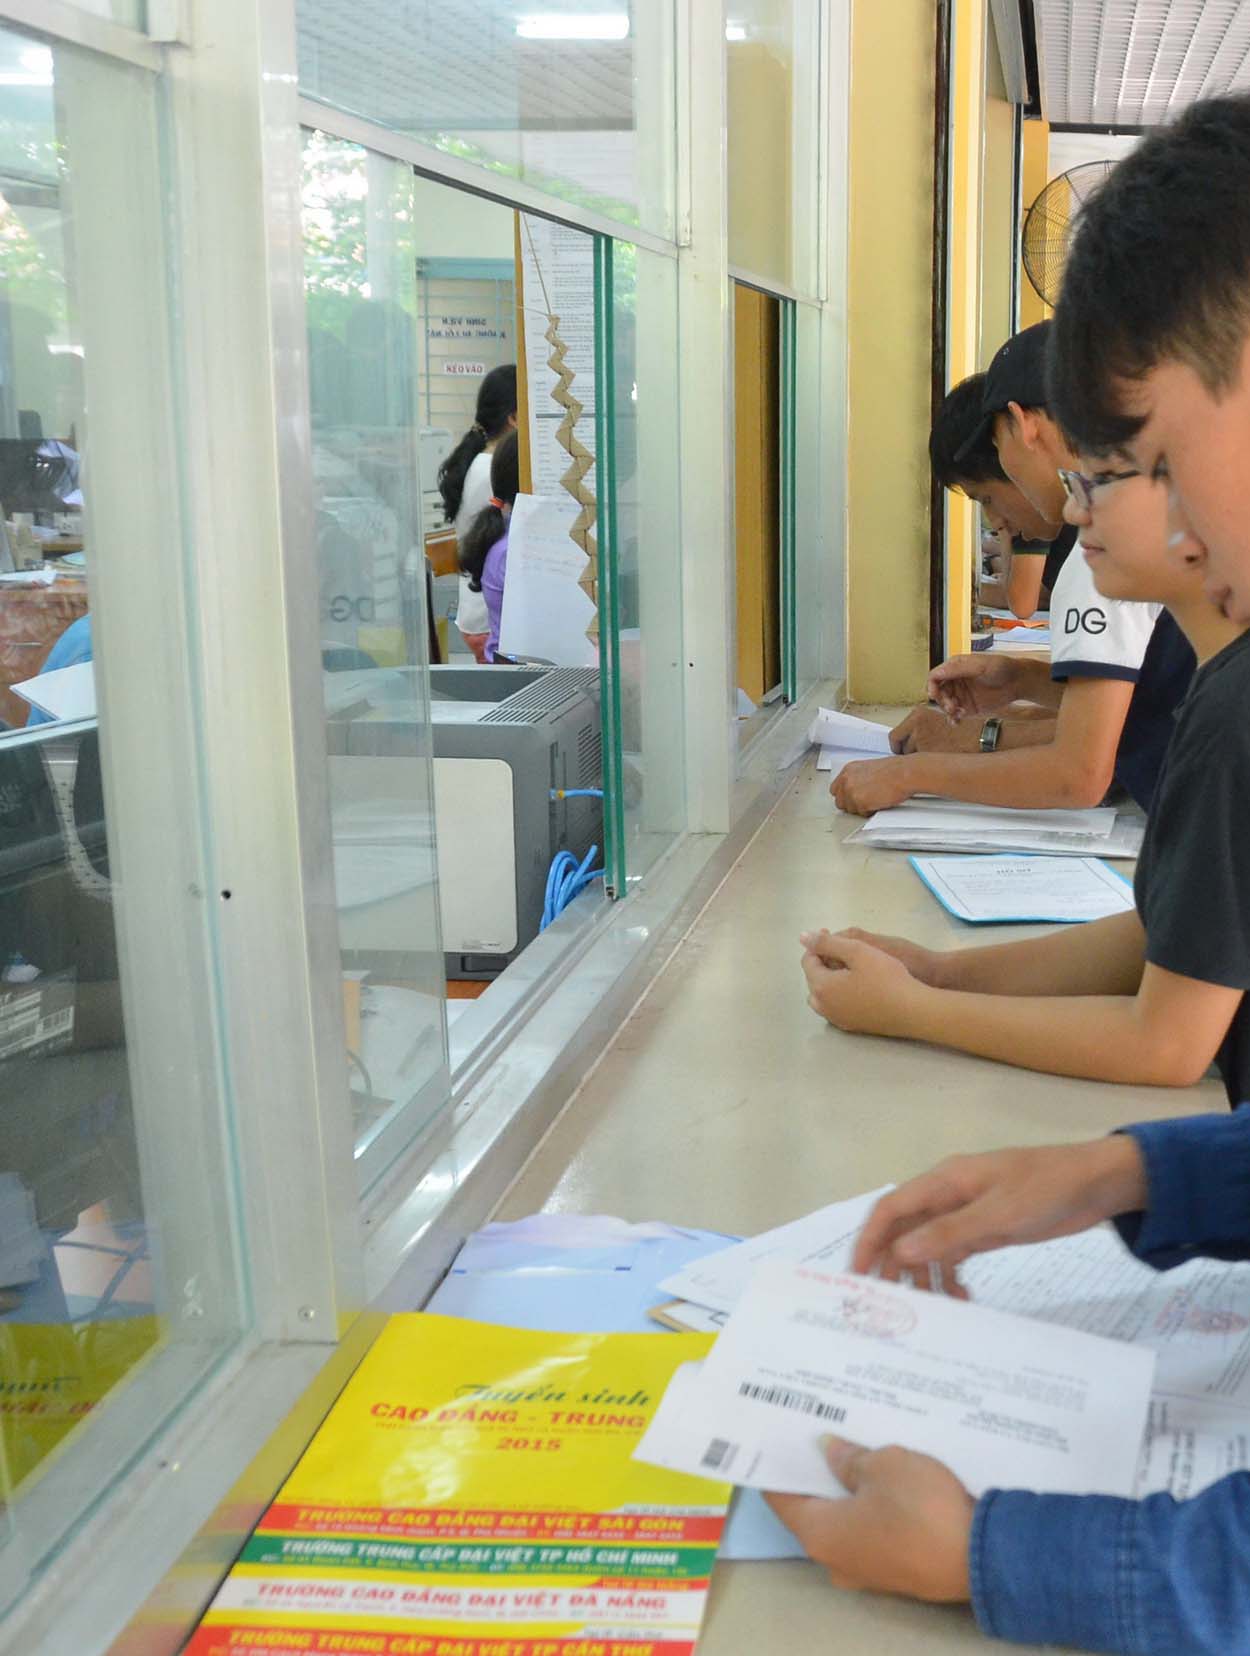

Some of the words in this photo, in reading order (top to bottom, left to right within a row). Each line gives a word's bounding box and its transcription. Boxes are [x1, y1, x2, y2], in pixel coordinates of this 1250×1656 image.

[1064, 607, 1107, 635] DG
[370, 1403, 429, 1422] CAO
[550, 1410, 647, 1428] TRUNG
[496, 1437, 562, 1452] 2015
[357, 1543, 416, 1560] TRUNG
[539, 1550, 564, 1563] TP
[630, 1551, 680, 1567] MINH
[351, 1586, 396, 1600] CAO
[316, 1634, 386, 1652] TRUNG
